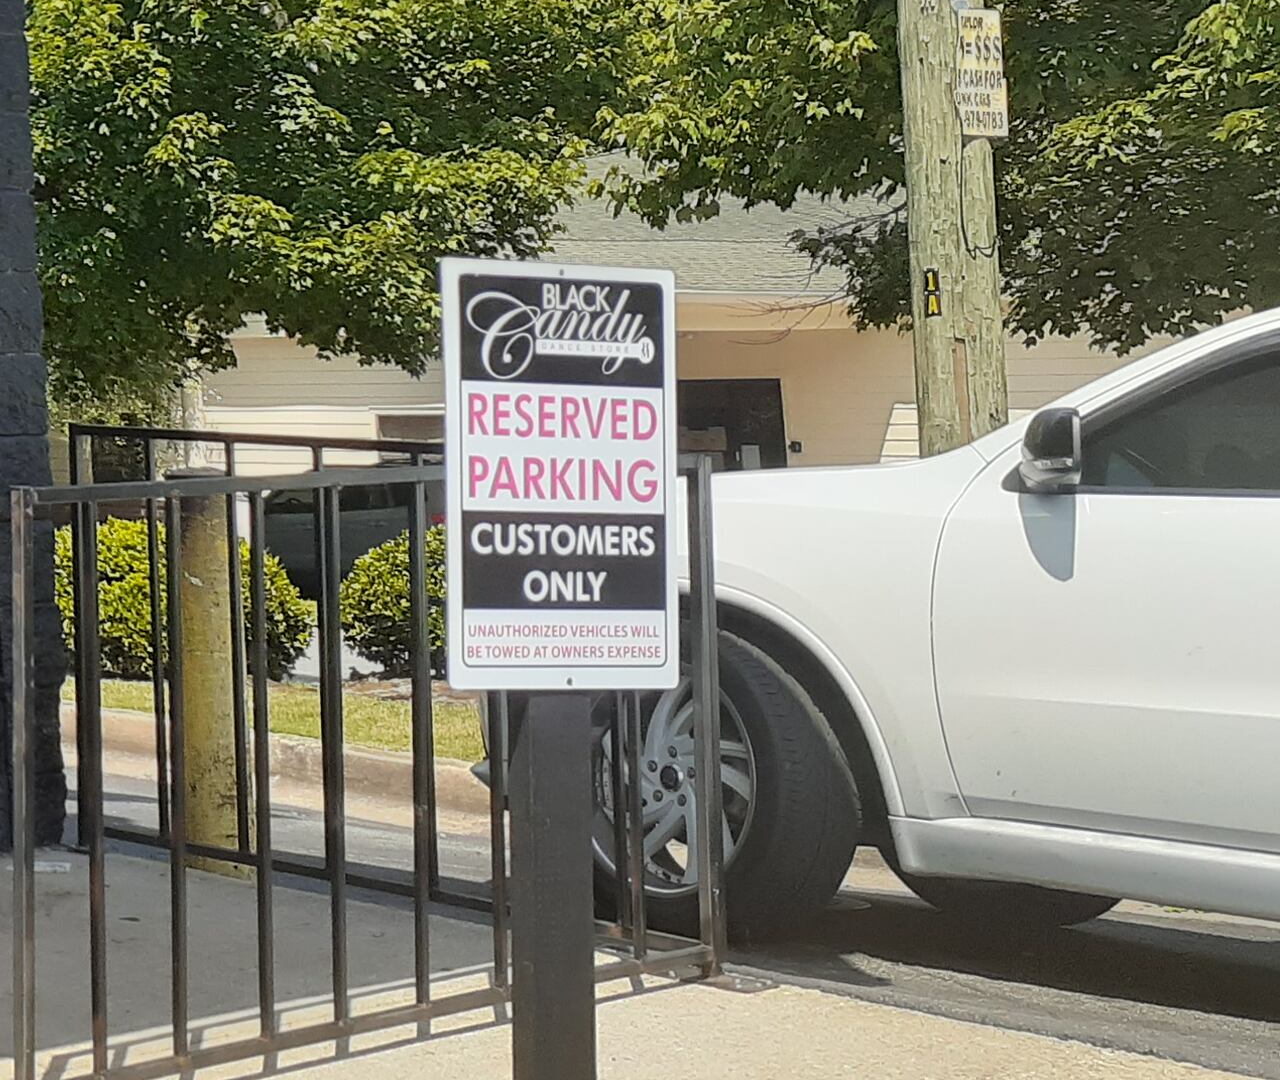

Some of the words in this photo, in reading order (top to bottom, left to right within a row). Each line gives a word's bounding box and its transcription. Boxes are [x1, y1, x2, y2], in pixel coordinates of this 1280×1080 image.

[542, 283, 611, 312] BLACK
[466, 289, 646, 379] Candy
[468, 392, 657, 441] RESERVED
[468, 455, 658, 503] PARKING
[471, 522, 655, 556] CUSTOMERS
[523, 570, 607, 602] ONLY
[468, 624, 568, 638] UNAUTHORIZED
[571, 625, 629, 638] VEHICLES
[631, 625, 660, 638] WILL
[467, 645, 483, 658] BE
[484, 645, 531, 658] TOWED
[533, 646, 549, 658] AT
[551, 646, 605, 658] OWNERS
[607, 646, 661, 658] EXPENSE
